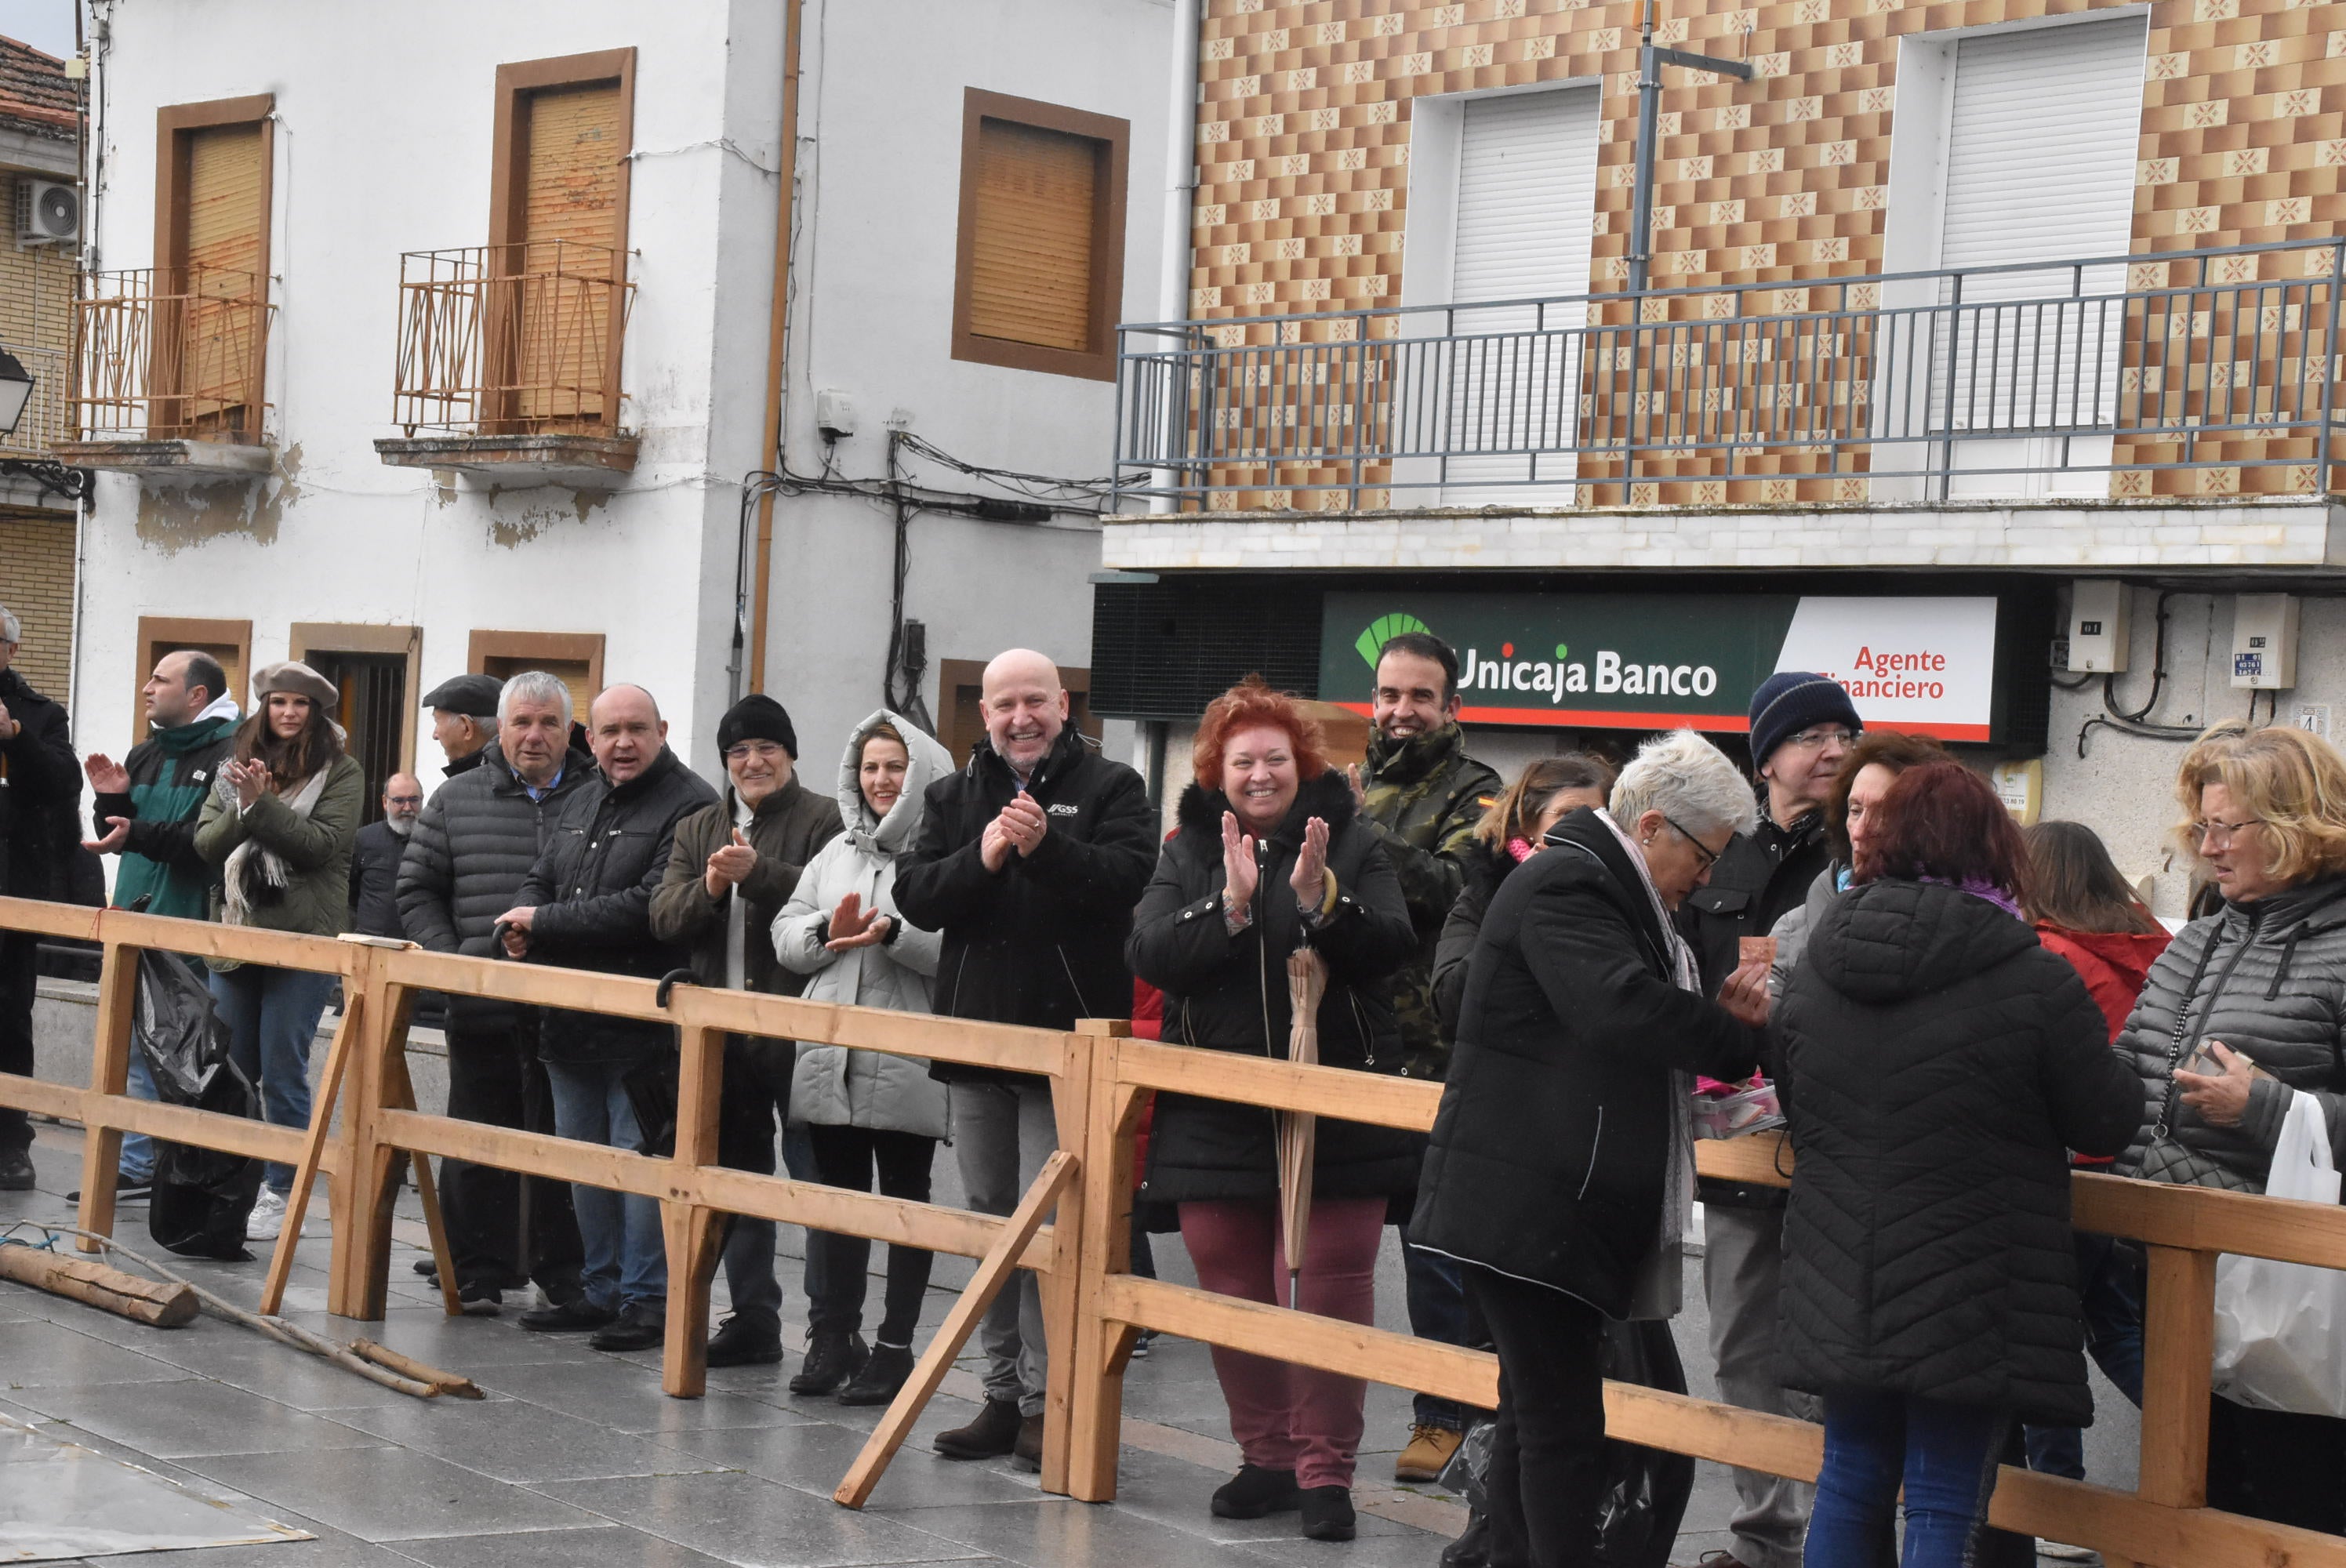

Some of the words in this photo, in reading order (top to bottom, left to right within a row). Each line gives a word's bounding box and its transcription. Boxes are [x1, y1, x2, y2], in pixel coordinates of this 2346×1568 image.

[1453, 642, 1589, 704] Unicaja
[1595, 651, 1717, 696] Banco
[1854, 646, 1946, 677] Agente
[1818, 672, 1945, 699] nanciero
